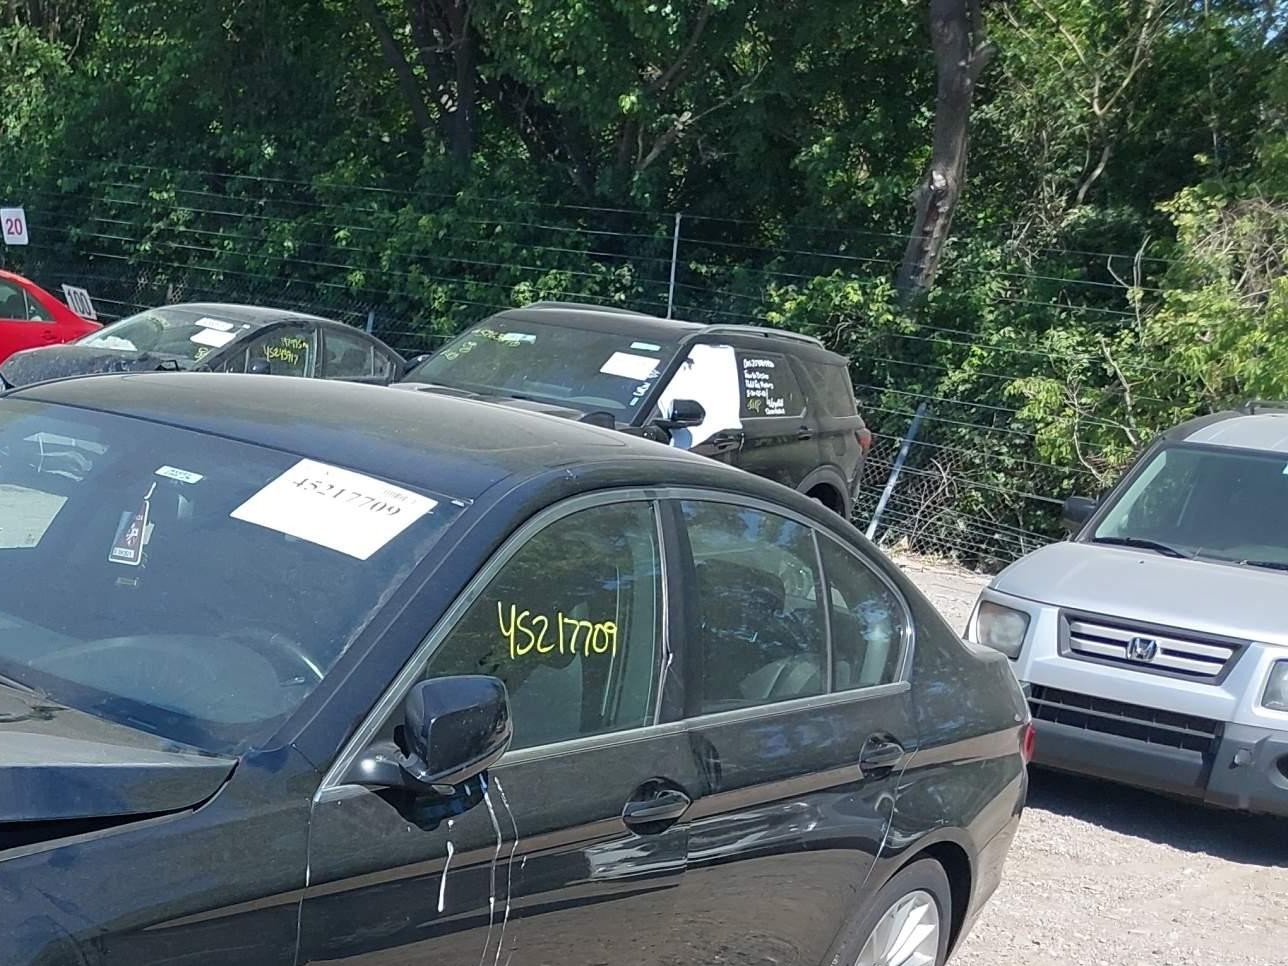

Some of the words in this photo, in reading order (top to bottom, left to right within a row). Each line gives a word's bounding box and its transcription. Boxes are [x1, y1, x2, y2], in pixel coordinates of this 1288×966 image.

[6, 218, 23, 236] 20
[67, 288, 93, 317] 100
[497, 600, 617, 660] 45217709
